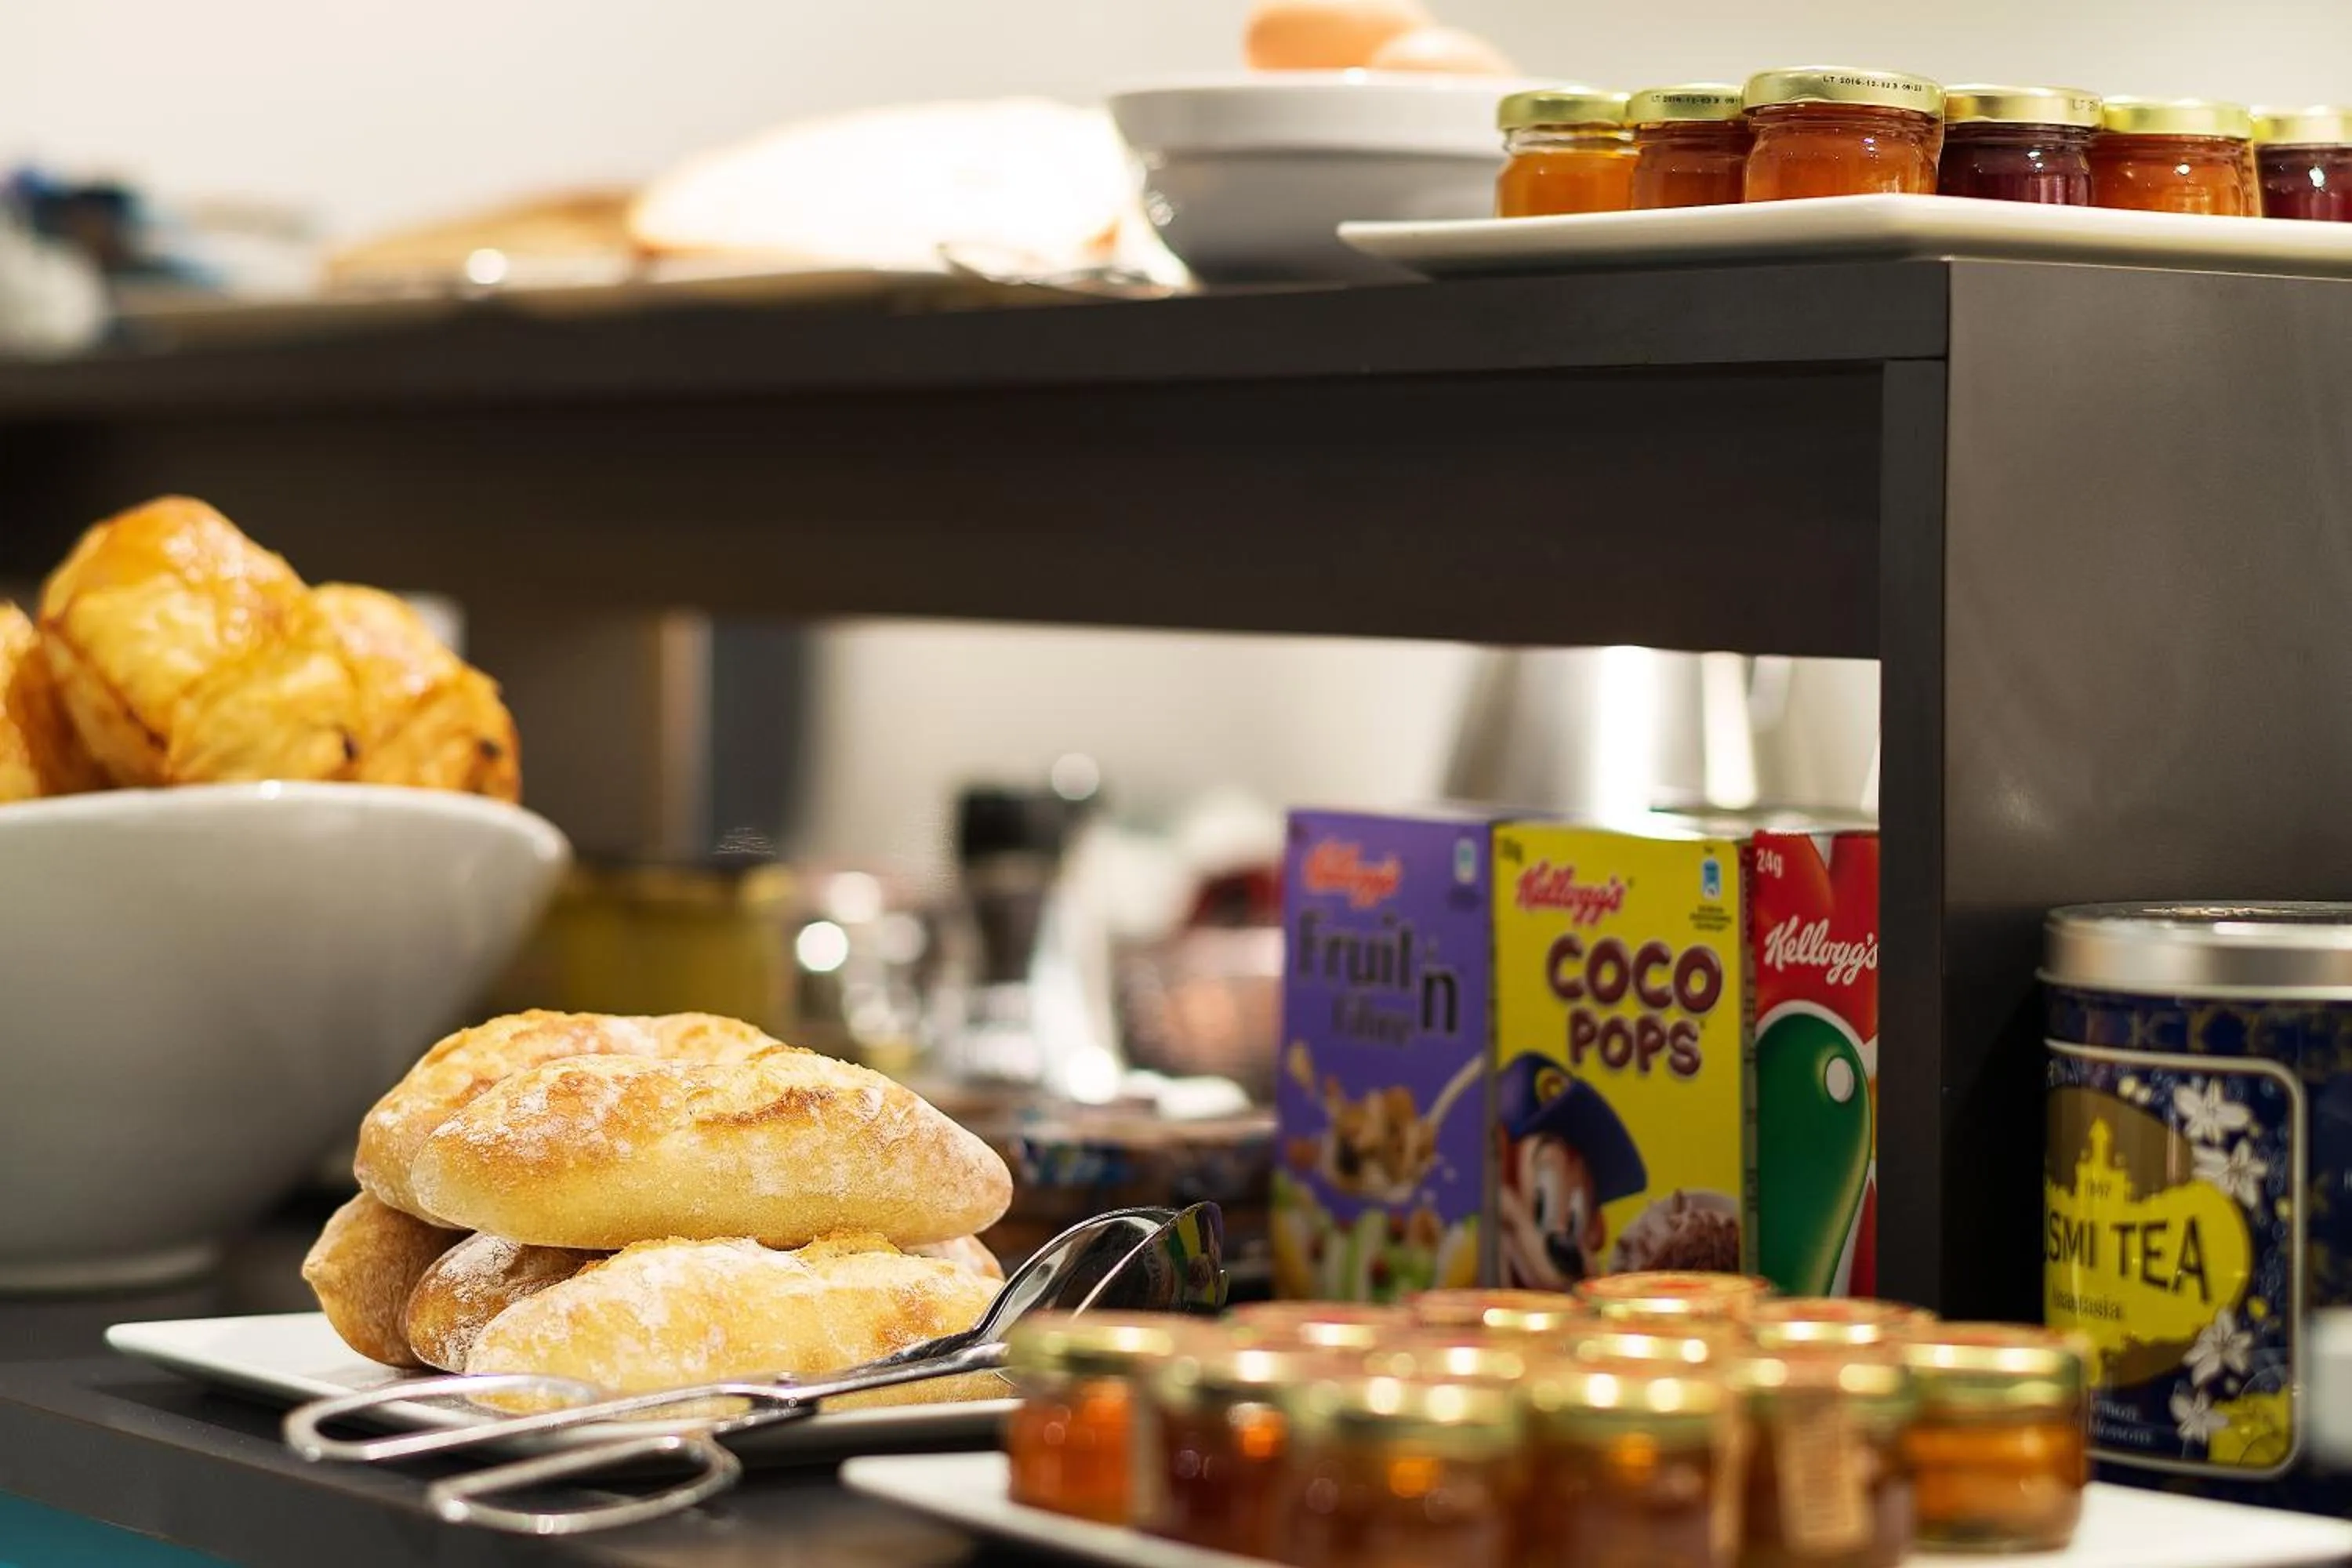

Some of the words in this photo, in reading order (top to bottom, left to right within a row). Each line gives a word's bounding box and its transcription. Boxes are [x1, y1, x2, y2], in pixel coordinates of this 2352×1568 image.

[1517, 859, 1626, 927] Kellogg's
[1756, 848, 1783, 879] 24g
[1547, 931, 1723, 1014] COCO
[1765, 915, 1878, 985] Kellogg's
[1569, 1007, 1701, 1078] POPS
[2044, 1210, 2096, 1269] SMI
[2110, 1214, 2212, 1305] TEA
